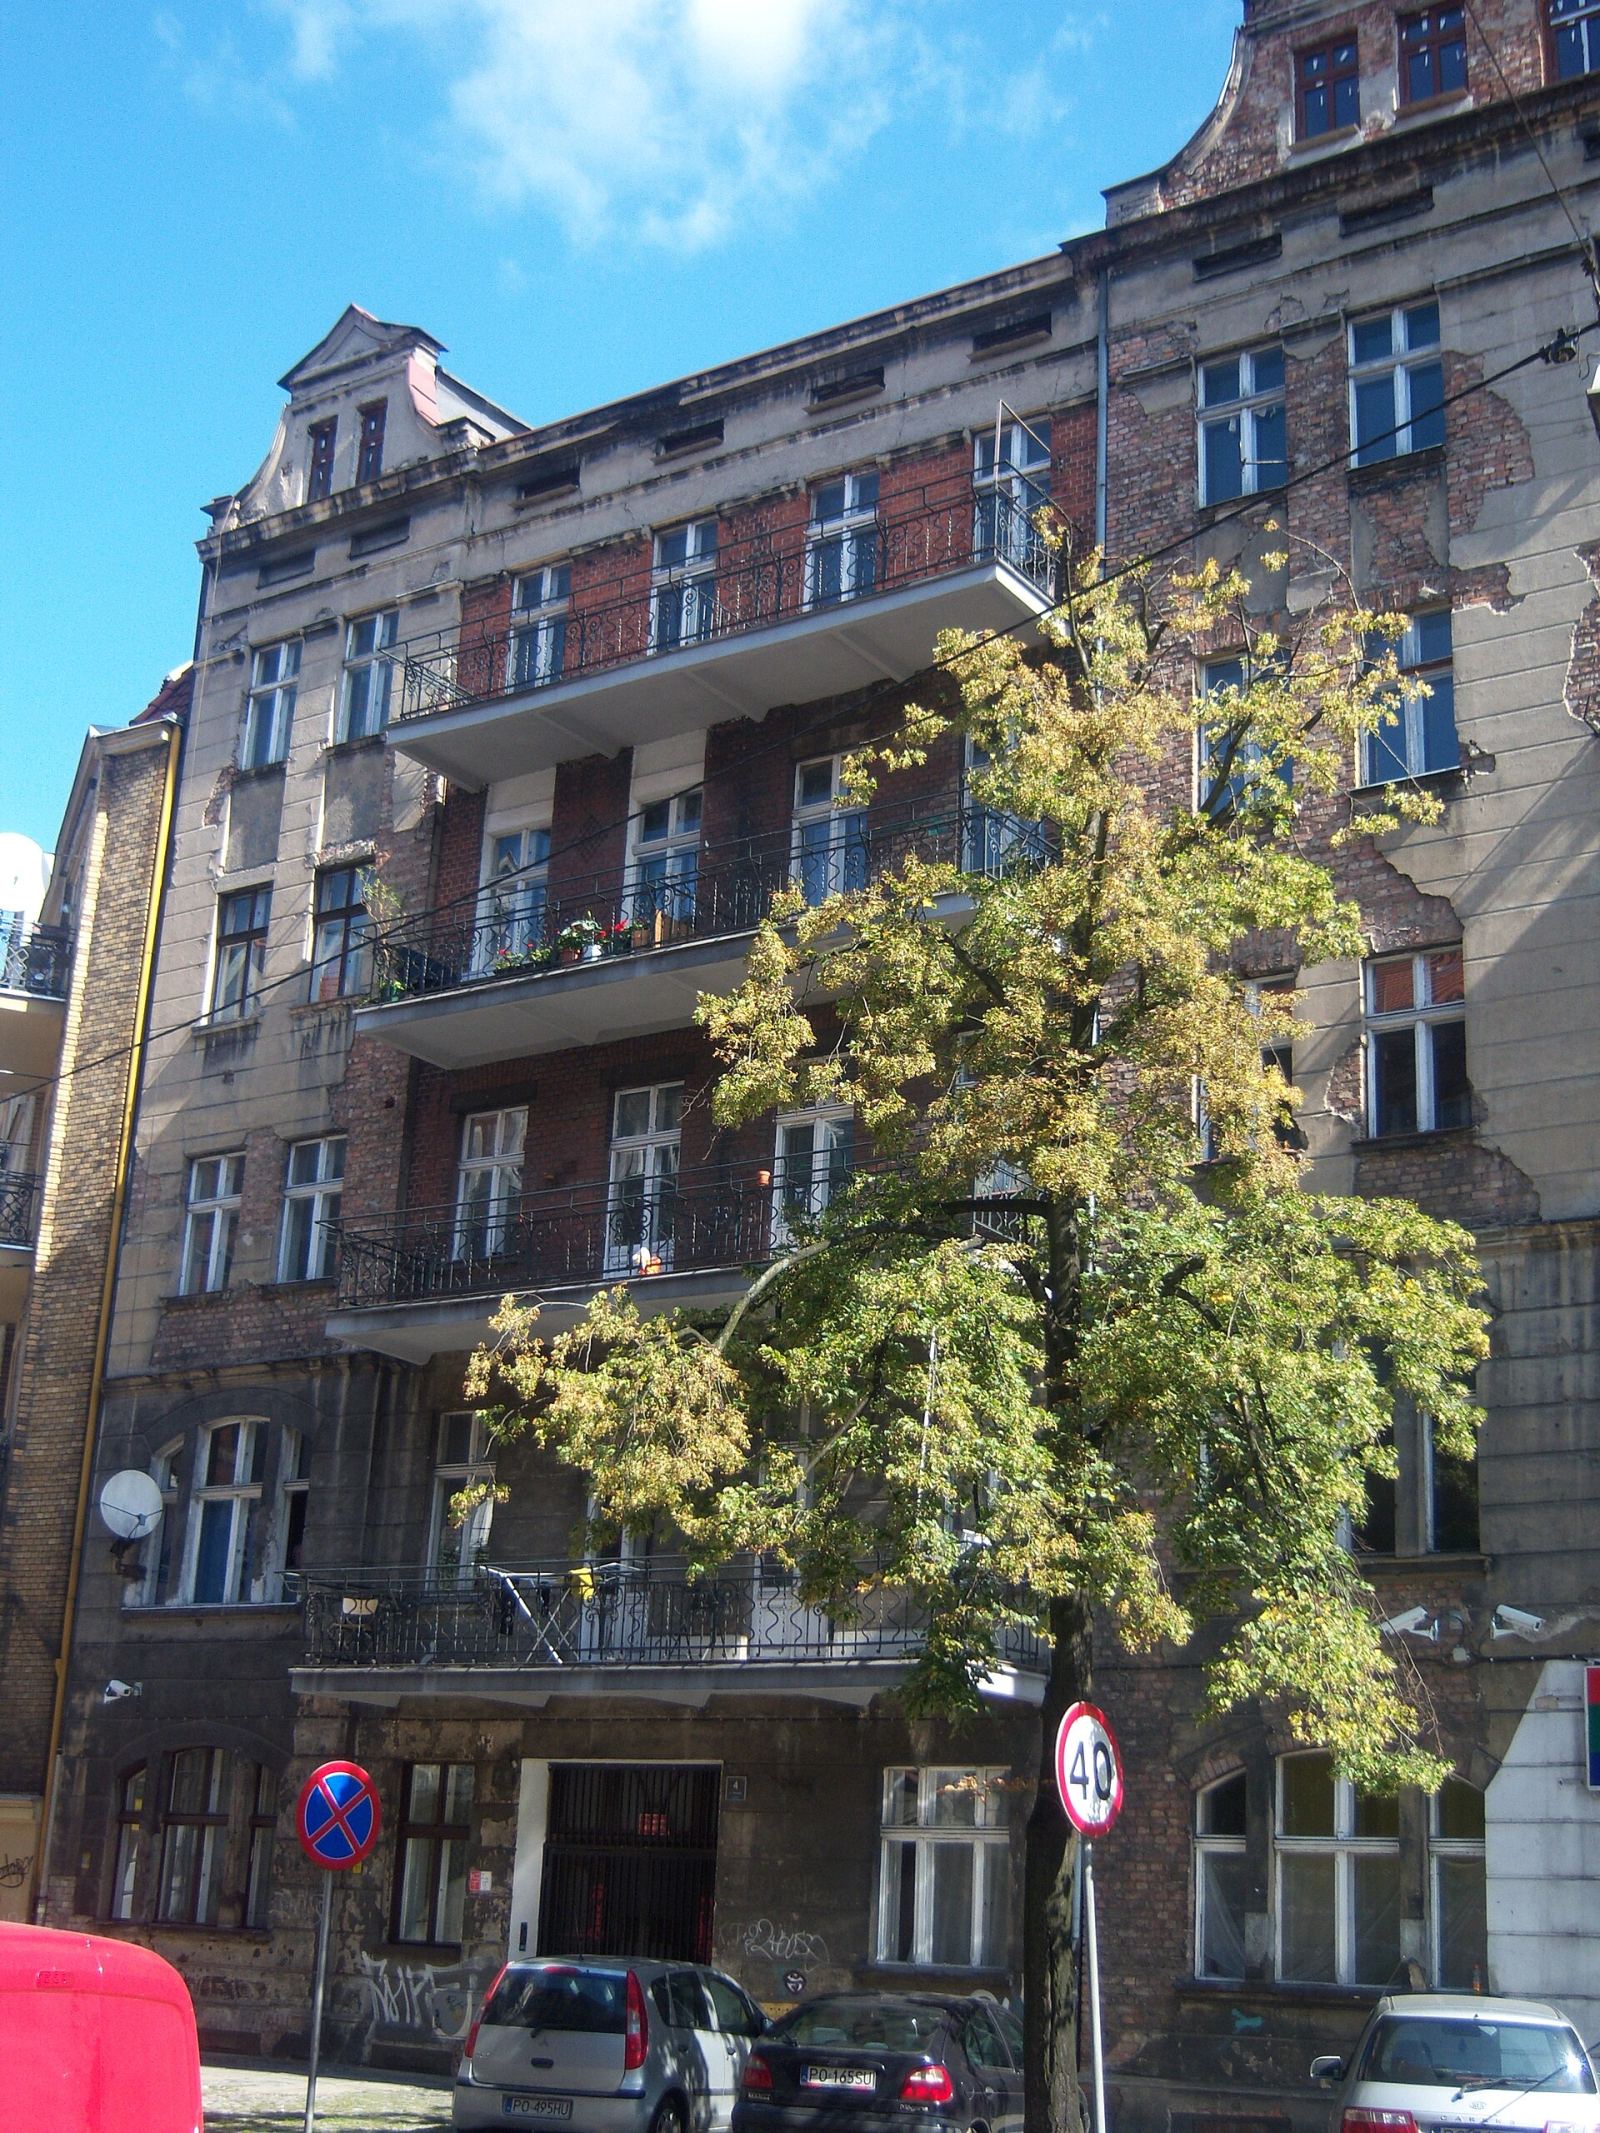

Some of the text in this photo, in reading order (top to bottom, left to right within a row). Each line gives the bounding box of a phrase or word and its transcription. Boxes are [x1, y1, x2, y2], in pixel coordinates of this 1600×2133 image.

[1069, 1741, 1112, 1800] 40
[809, 2068, 872, 2085] PO 165SU
[512, 2100, 568, 2115] PO 495HU
